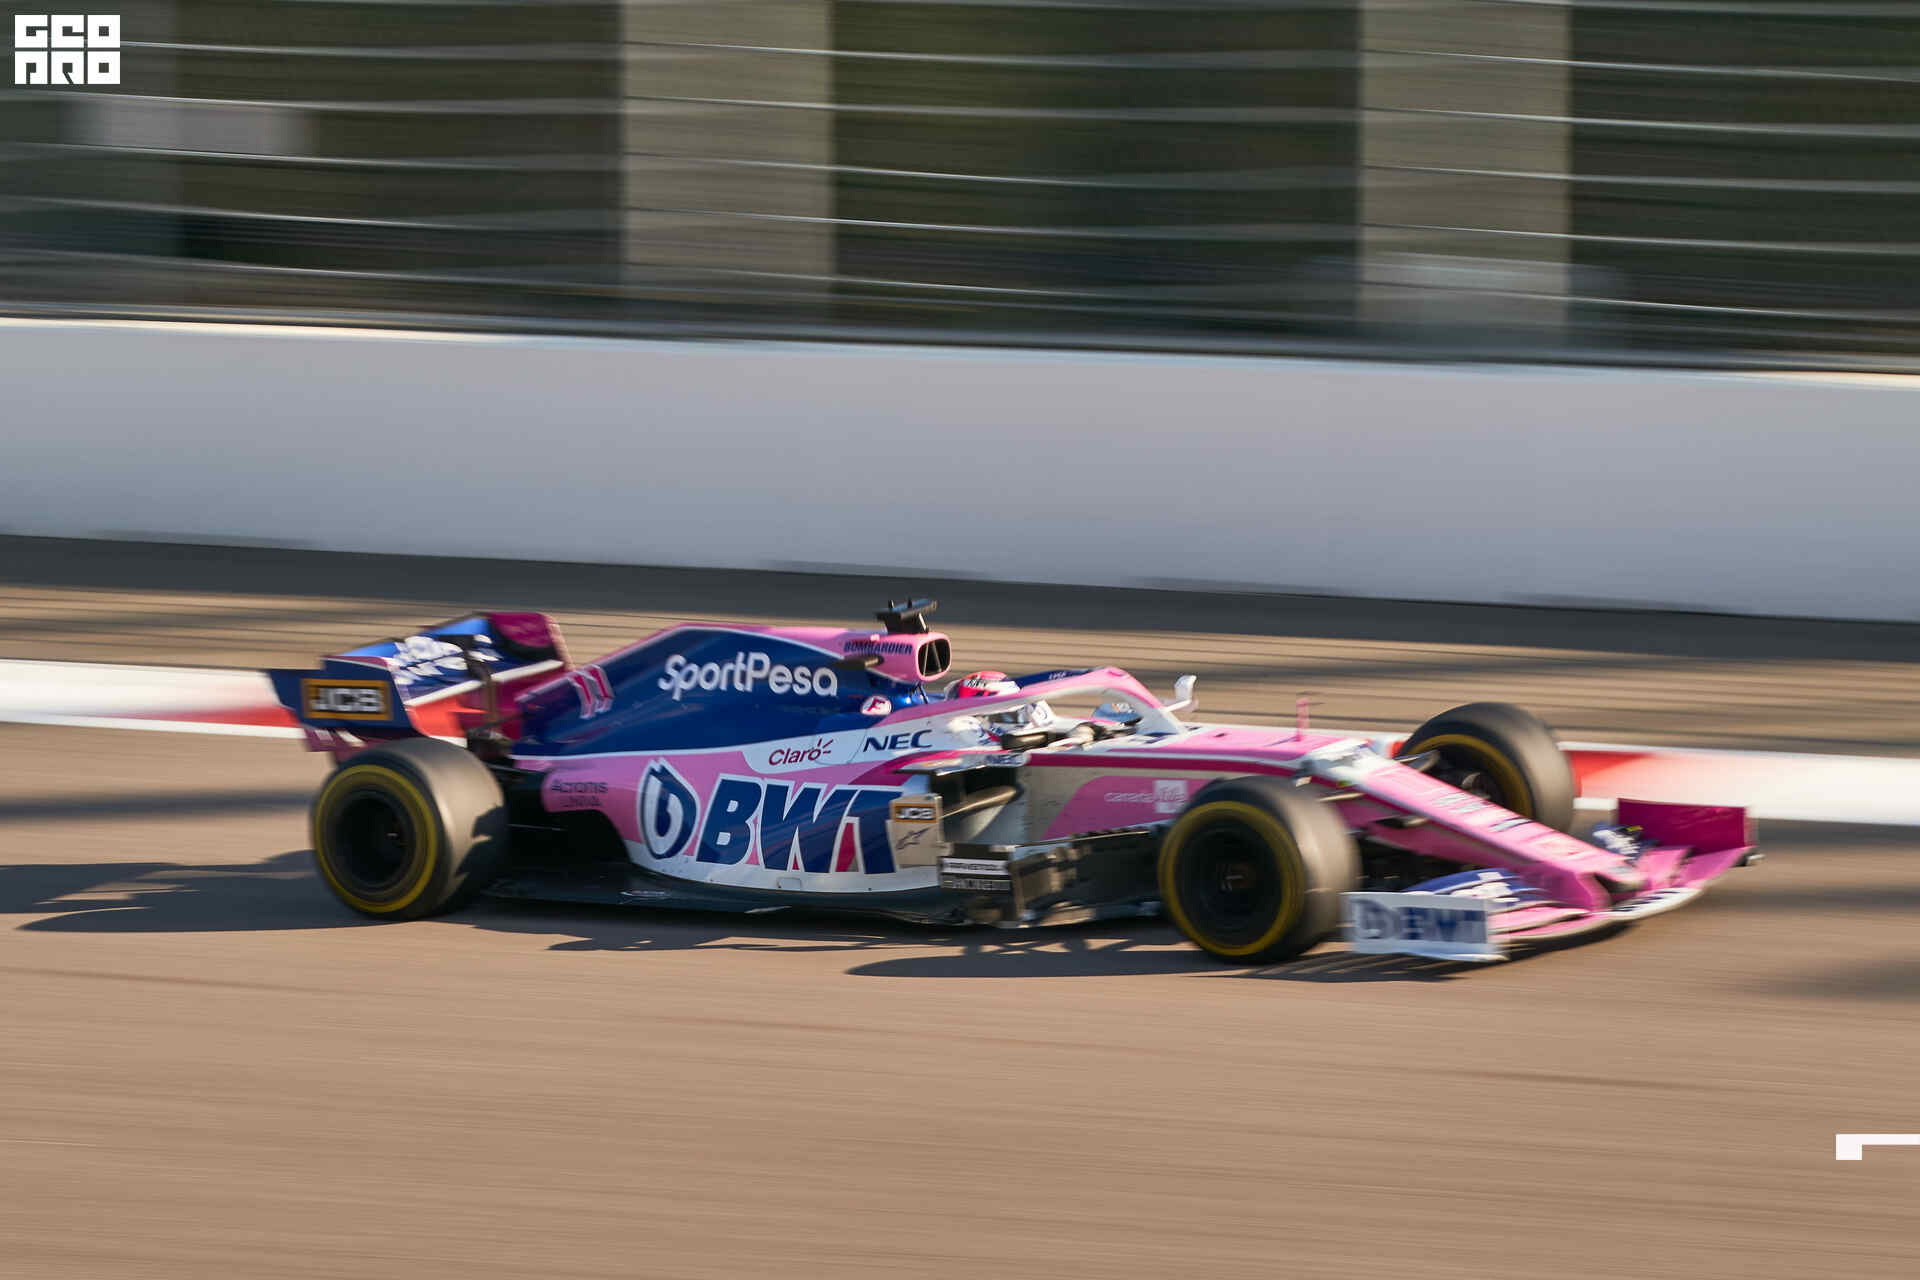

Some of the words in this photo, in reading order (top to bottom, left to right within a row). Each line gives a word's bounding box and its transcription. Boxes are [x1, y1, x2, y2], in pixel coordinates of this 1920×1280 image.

[658, 651, 838, 701] SportPesa
[862, 729, 933, 753] NEC
[768, 742, 827, 766] Claro
[695, 773, 904, 875] BWT
[896, 807, 935, 820] JCB
